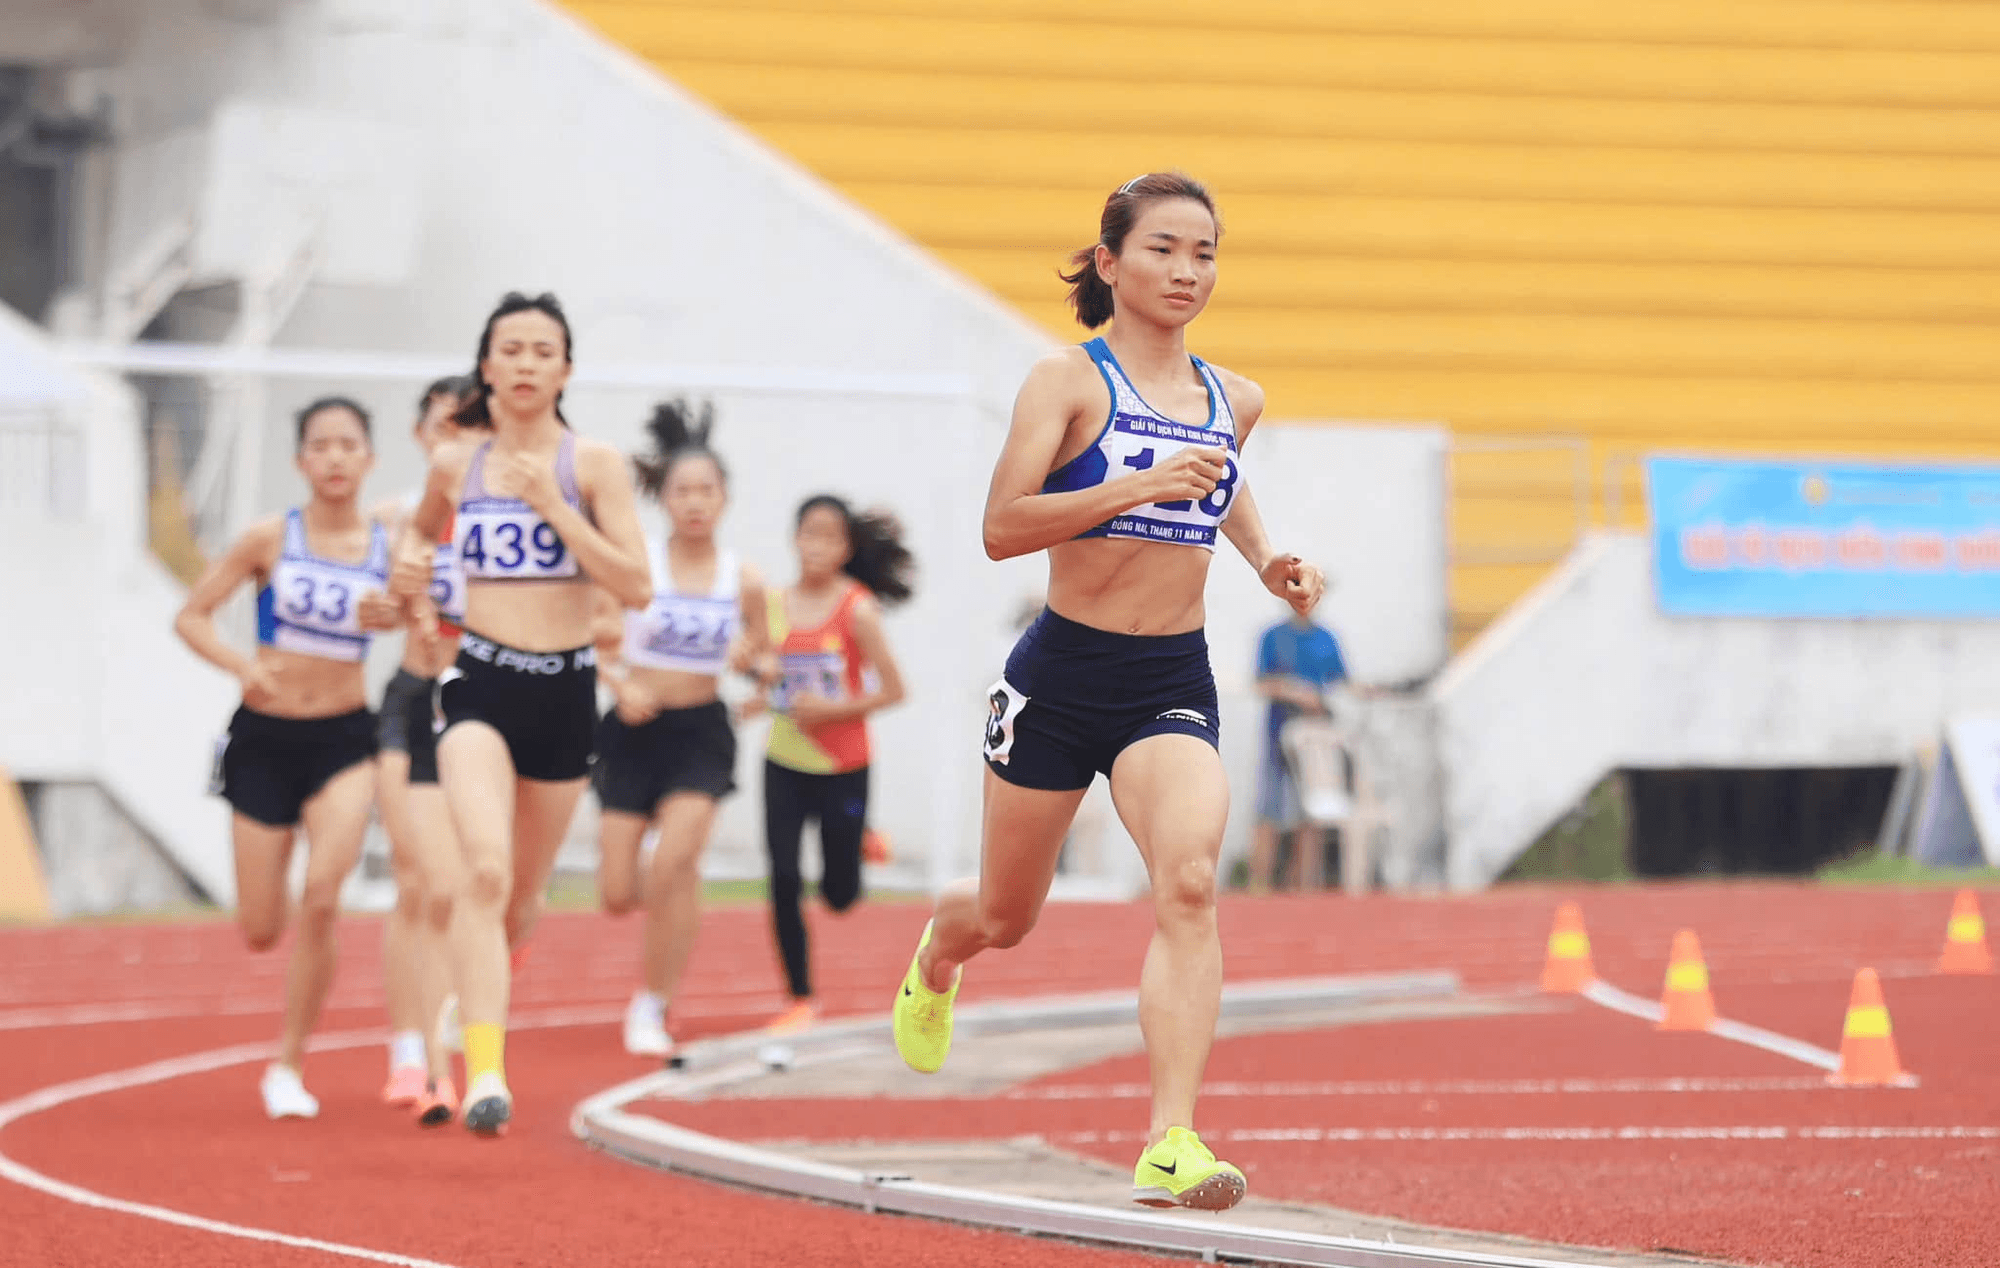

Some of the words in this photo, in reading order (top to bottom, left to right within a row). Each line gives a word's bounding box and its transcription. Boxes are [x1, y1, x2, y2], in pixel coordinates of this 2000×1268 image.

[1123, 448, 1238, 518] 18
[462, 521, 567, 570] 439
[495, 648, 566, 676] PRO
